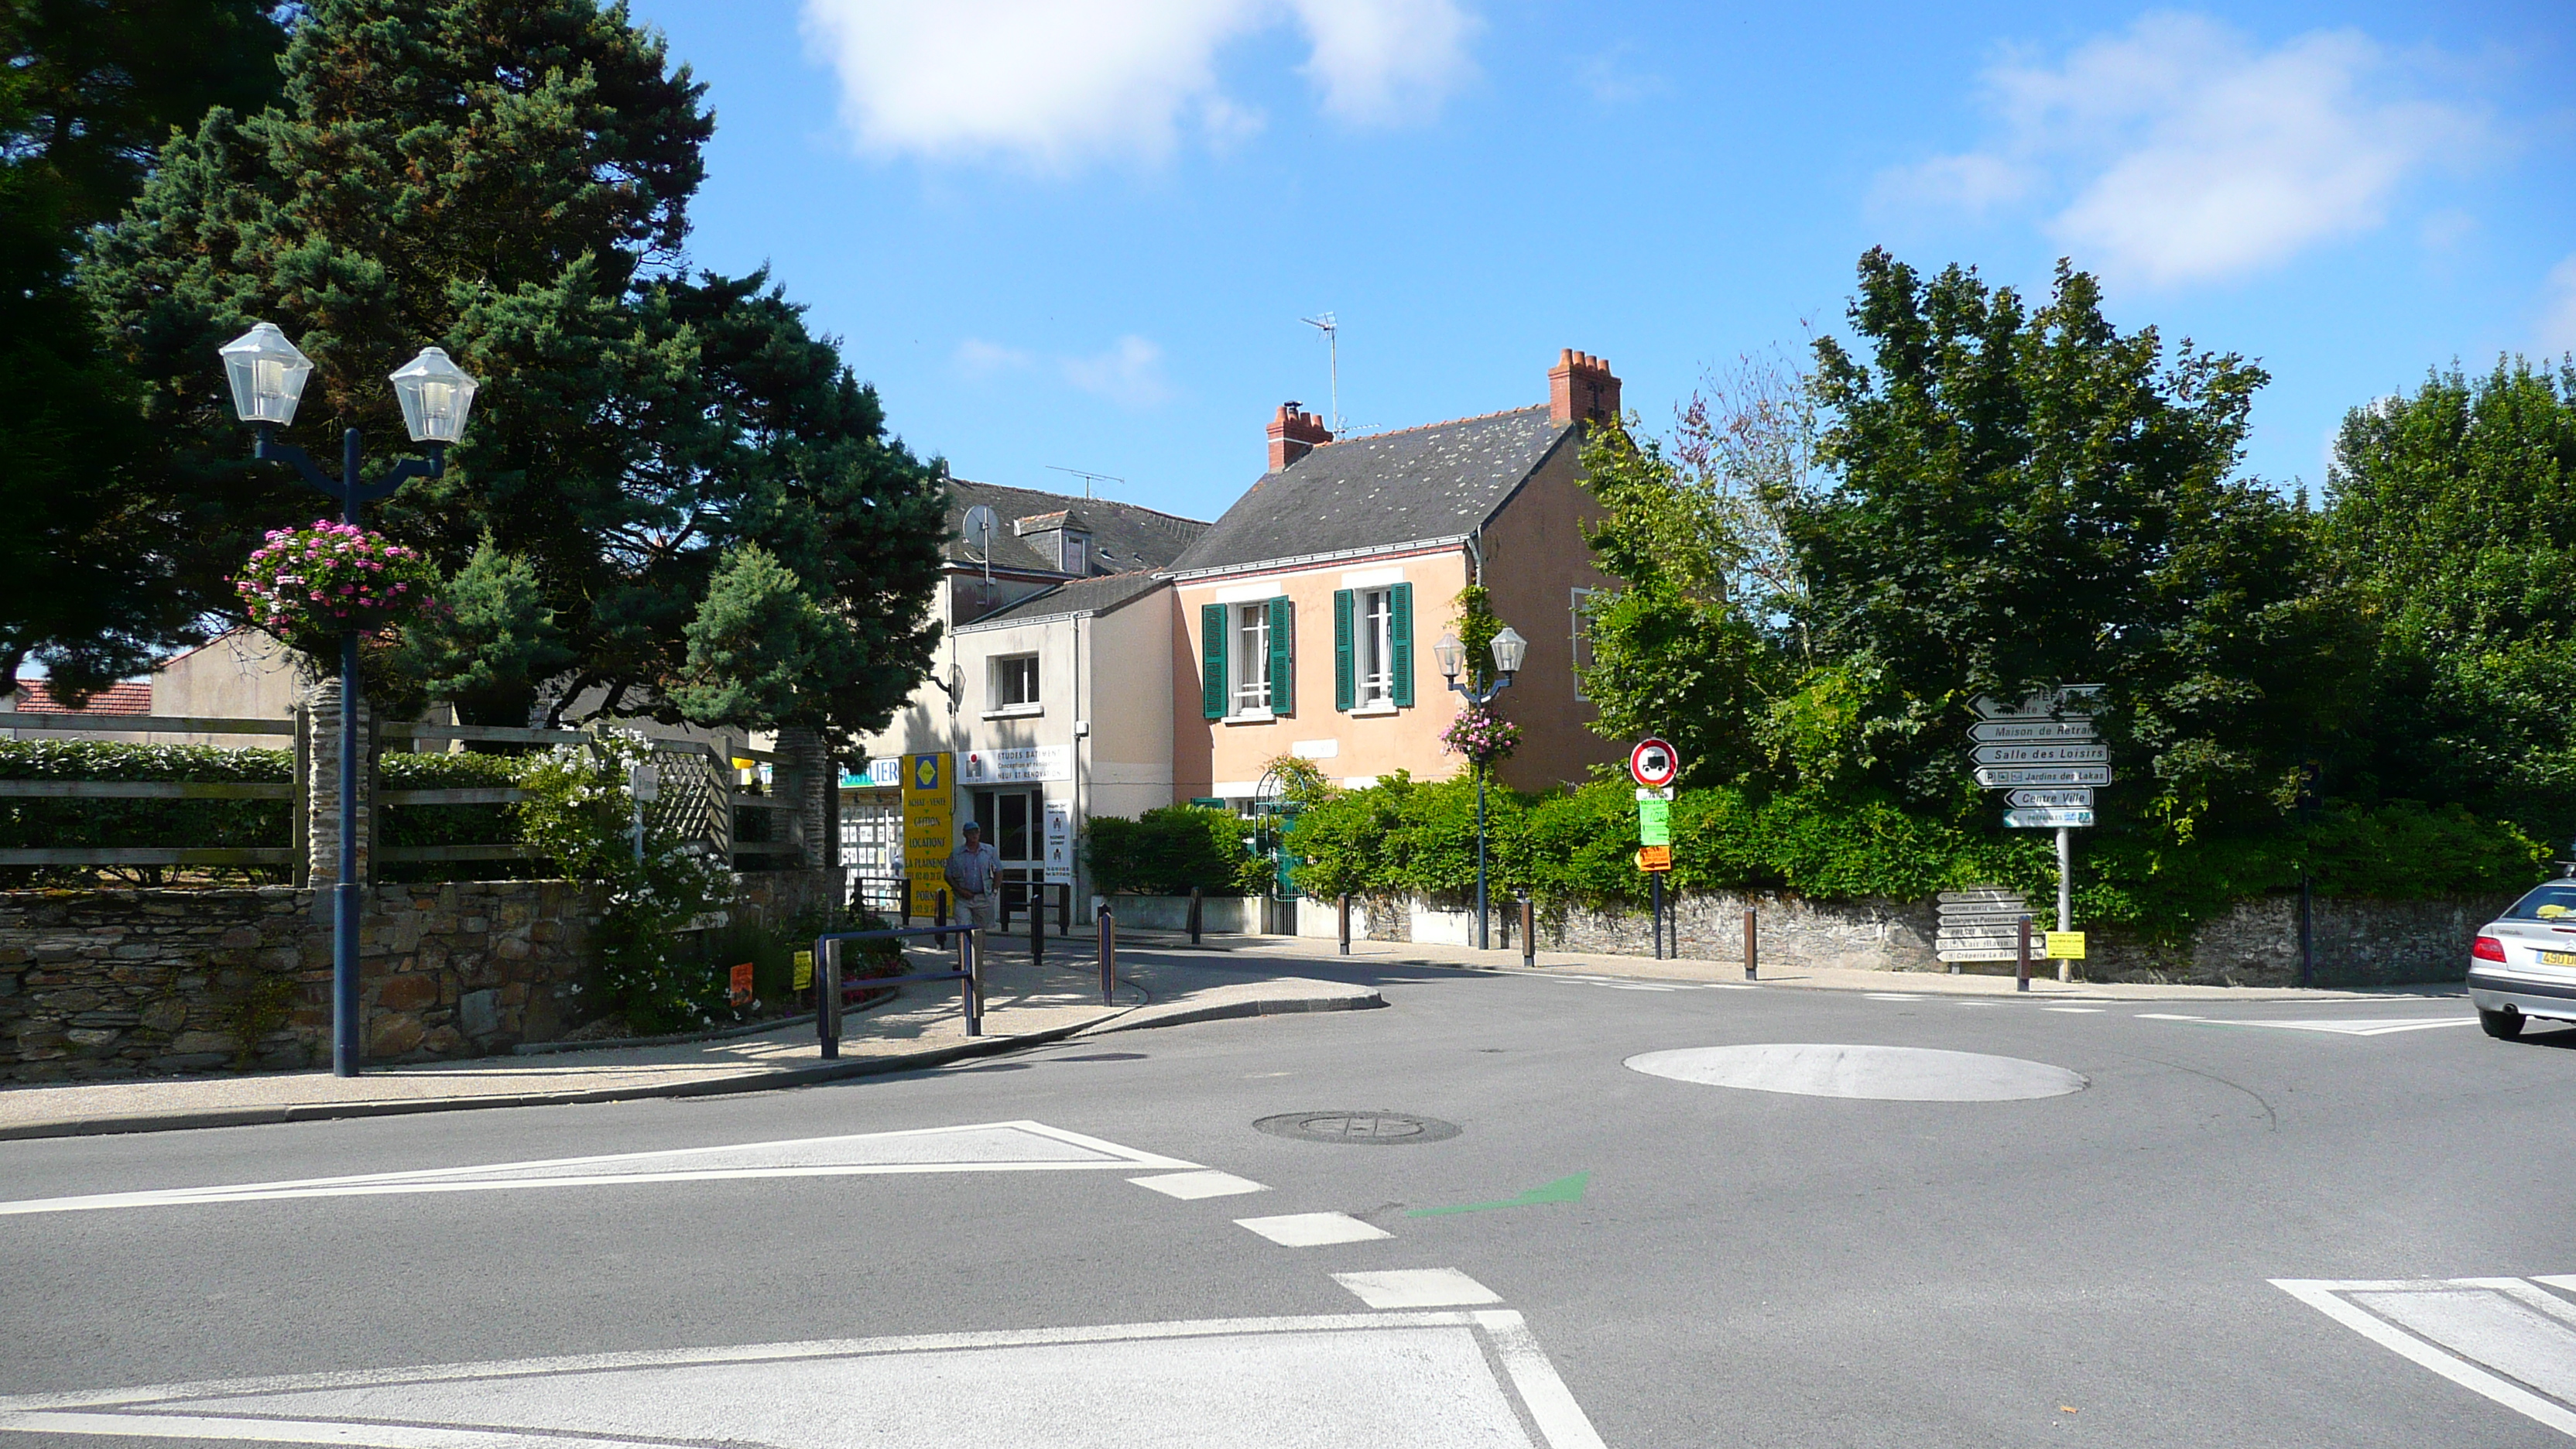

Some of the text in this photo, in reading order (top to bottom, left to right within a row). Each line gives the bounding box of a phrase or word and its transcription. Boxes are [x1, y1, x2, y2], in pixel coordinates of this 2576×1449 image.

[1995, 728, 2033, 737] Maison
[2039, 726, 2051, 735] de
[1995, 748, 2103, 759] Salle des Loisirs
[2023, 793, 2085, 803] Centre Ville
[909, 838, 946, 848] LOCATIONS
